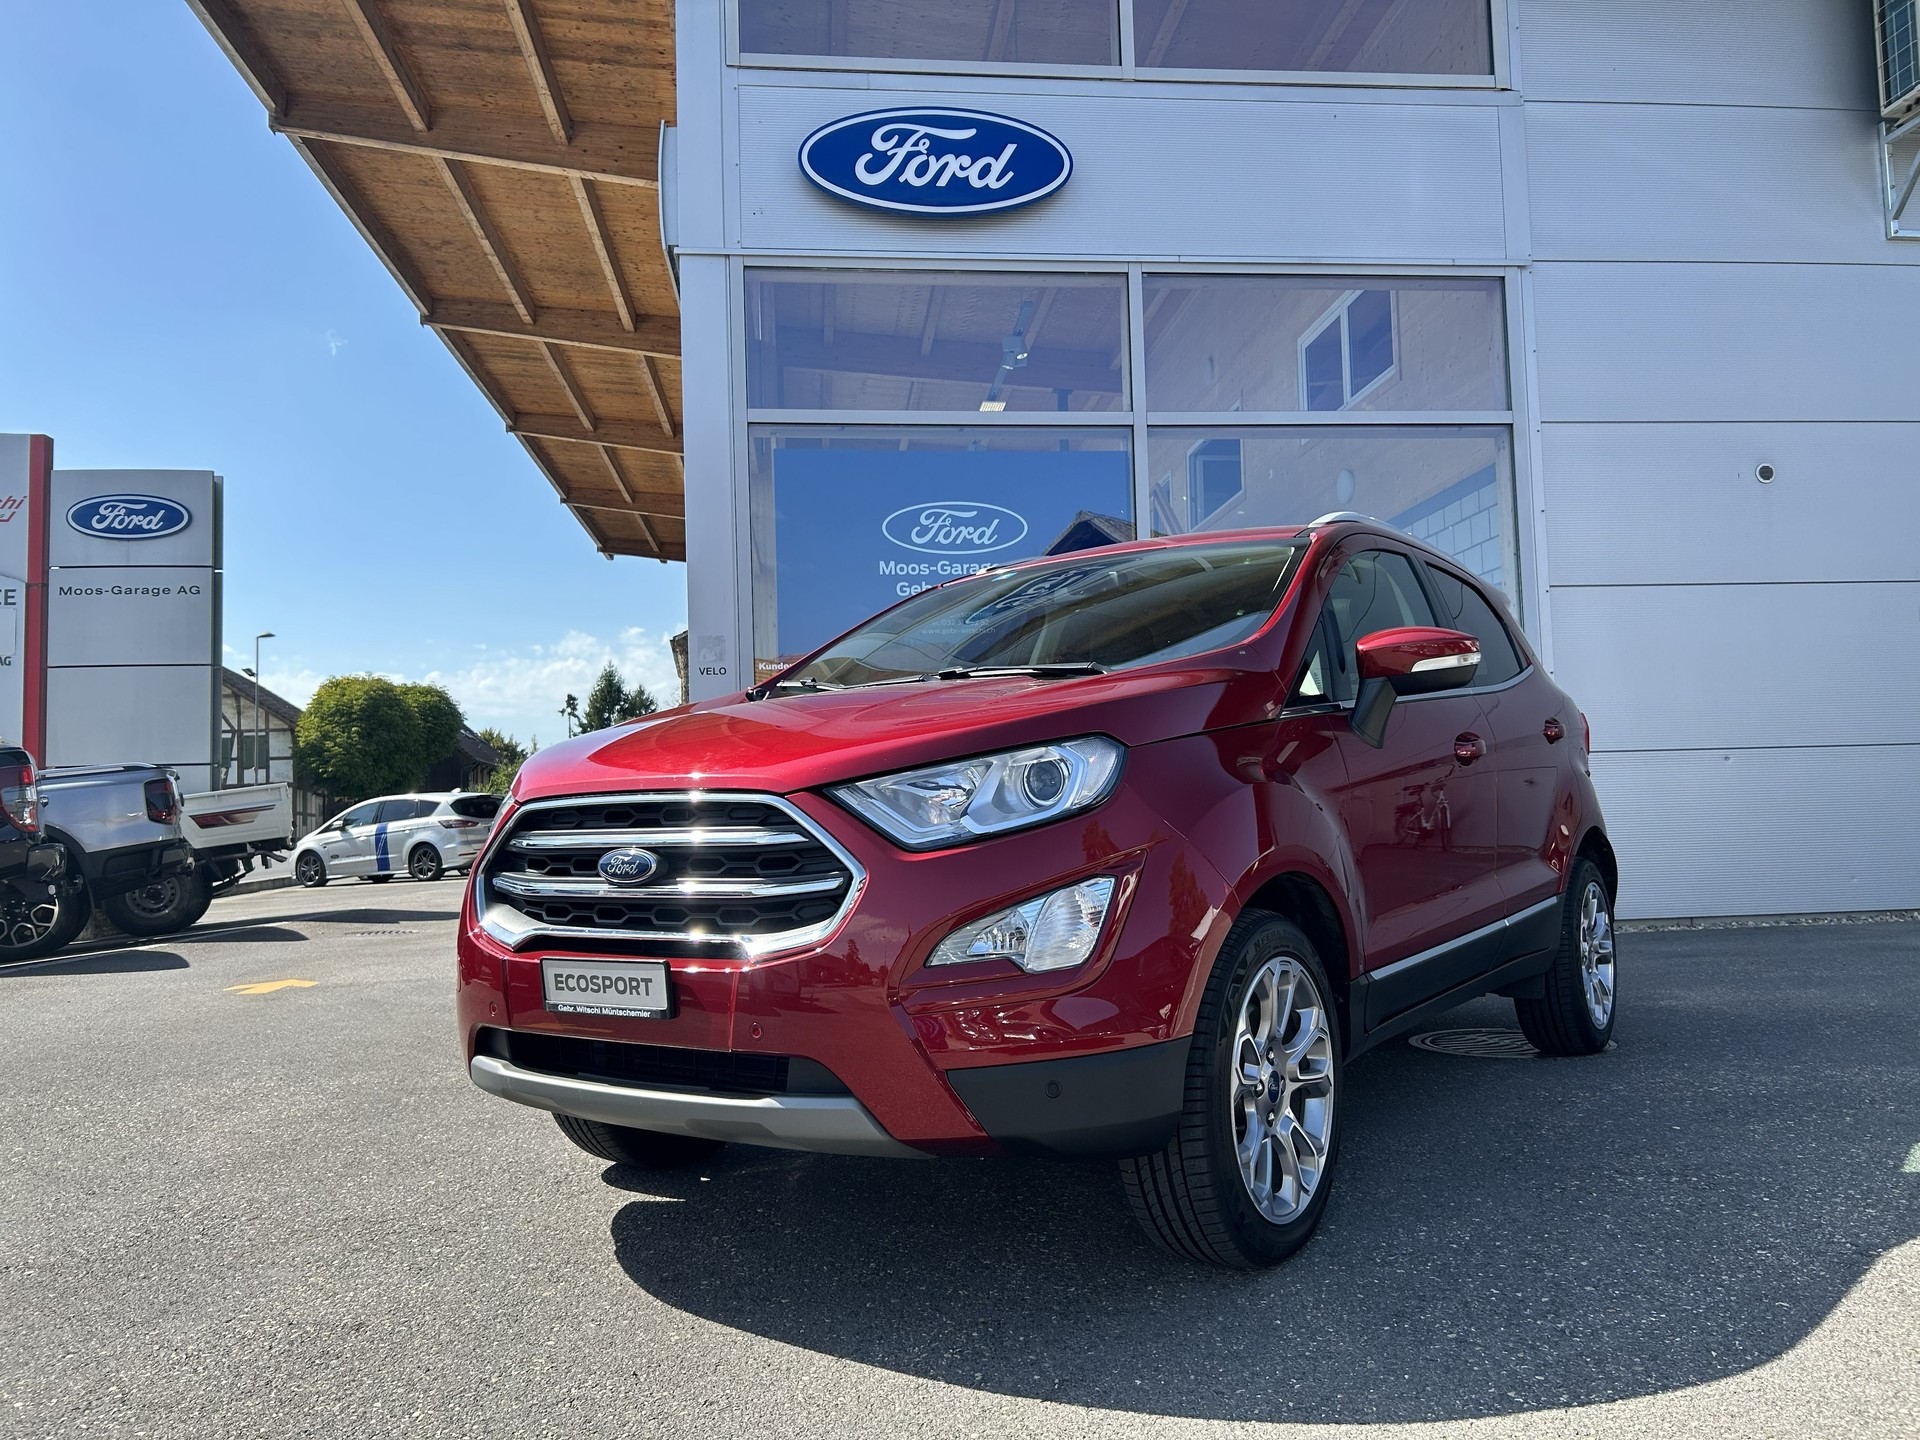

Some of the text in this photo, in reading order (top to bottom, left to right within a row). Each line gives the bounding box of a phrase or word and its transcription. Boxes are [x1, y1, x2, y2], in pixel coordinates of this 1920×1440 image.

[854, 122, 1018, 190] Ford
[0, 495, 28, 510] hi
[91, 501, 166, 530] Ford
[910, 508, 1000, 545] Ford
[879, 560, 999, 576] Moos-Gara
[58, 585, 201, 597] Moos-Garage AG
[699, 666, 727, 676] VELO
[607, 855, 640, 875] Ford
[553, 973, 653, 997] ECOSPORT
[557, 1004, 575, 1013] Gebr.
[576, 1005, 601, 1015] Witschi
